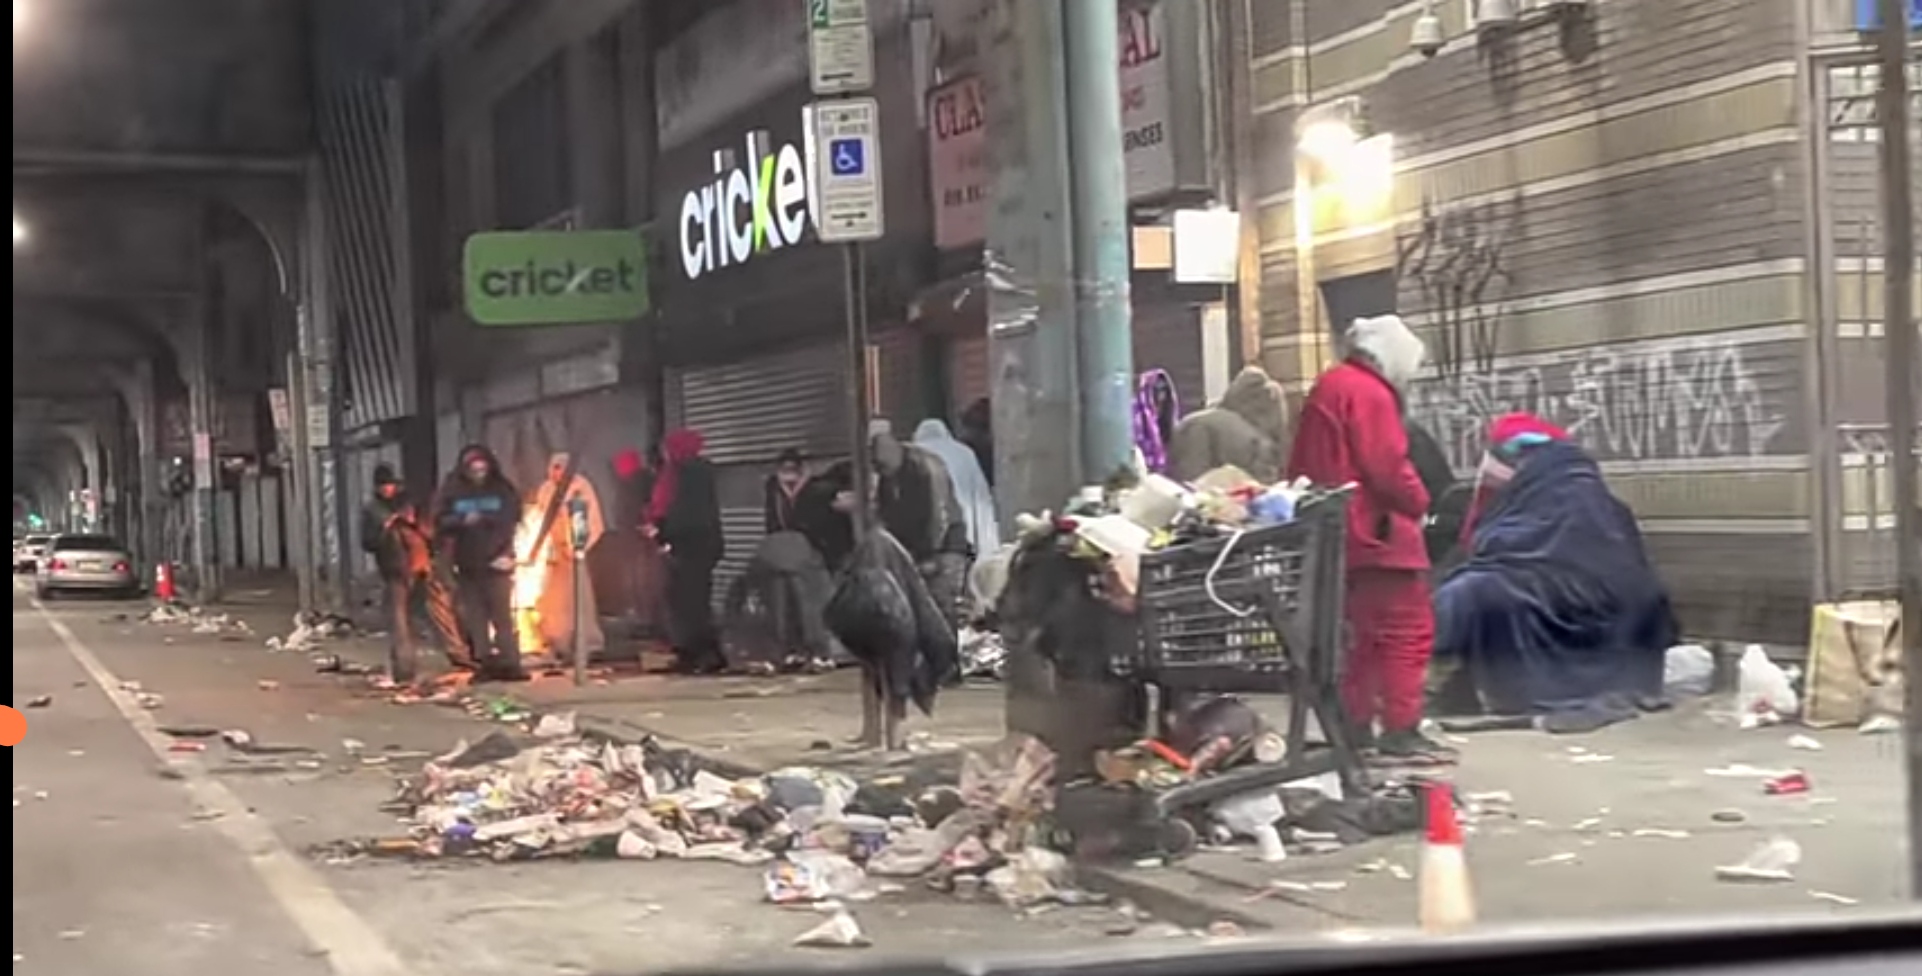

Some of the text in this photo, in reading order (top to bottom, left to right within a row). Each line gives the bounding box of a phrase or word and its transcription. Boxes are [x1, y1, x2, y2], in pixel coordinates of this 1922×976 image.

[1120, 9, 1162, 67] AL
[935, 78, 986, 140] CLA
[1123, 121, 1164, 153] ENSES
[479, 257, 636, 299] cricket
